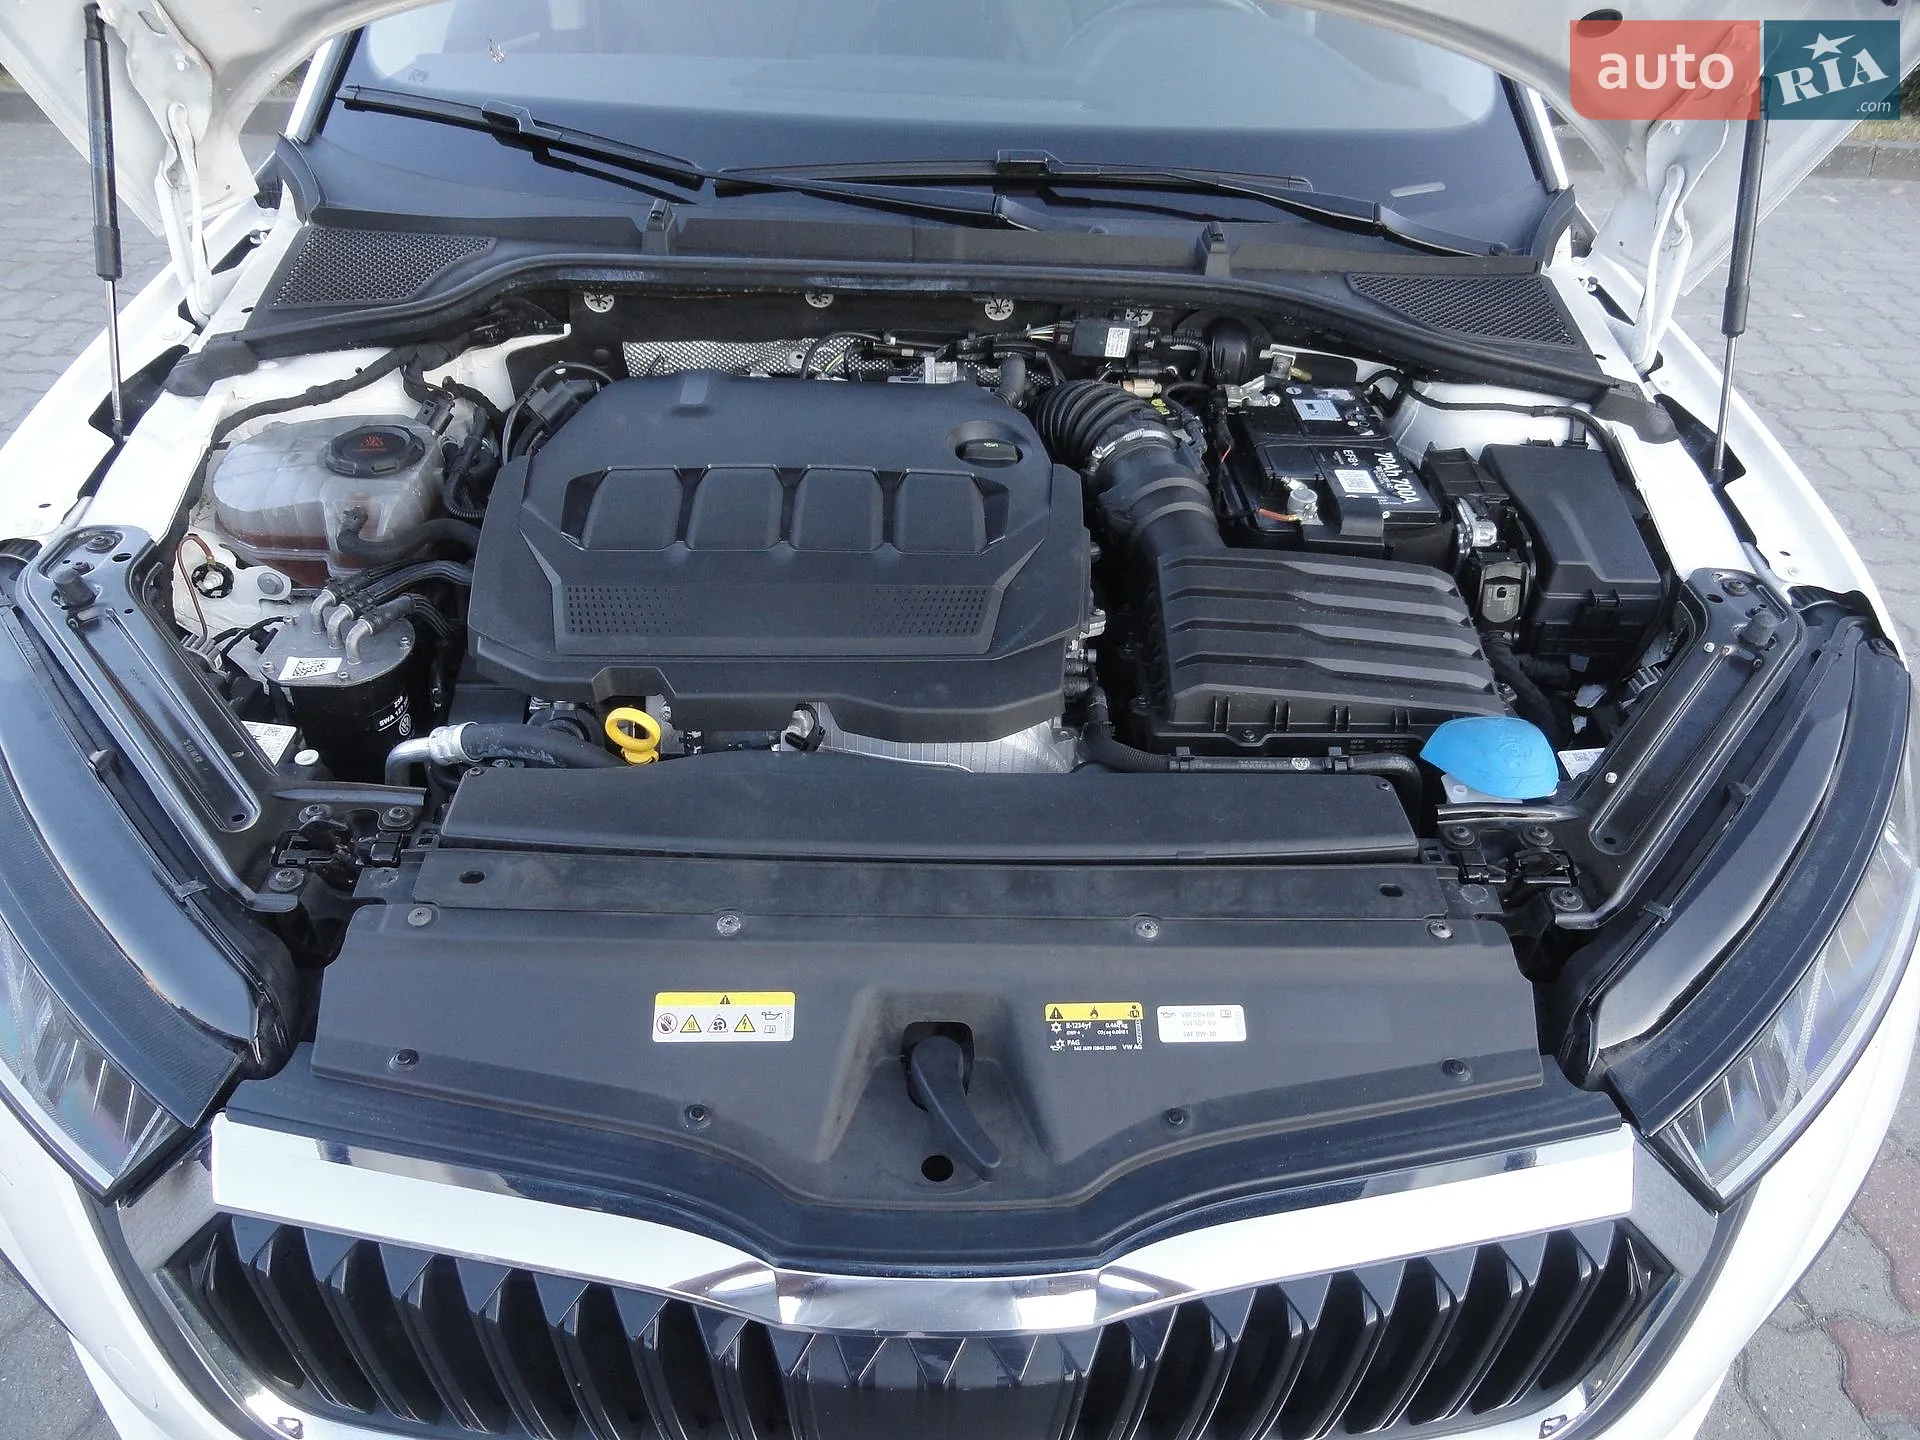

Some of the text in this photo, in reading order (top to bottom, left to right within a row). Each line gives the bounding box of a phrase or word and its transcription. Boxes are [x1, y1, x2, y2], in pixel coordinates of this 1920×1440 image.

[1374, 452, 1403, 477] 70Ah
[1391, 478, 1421, 504] 700A
[1065, 1022, 1092, 1031] R-1234yf
